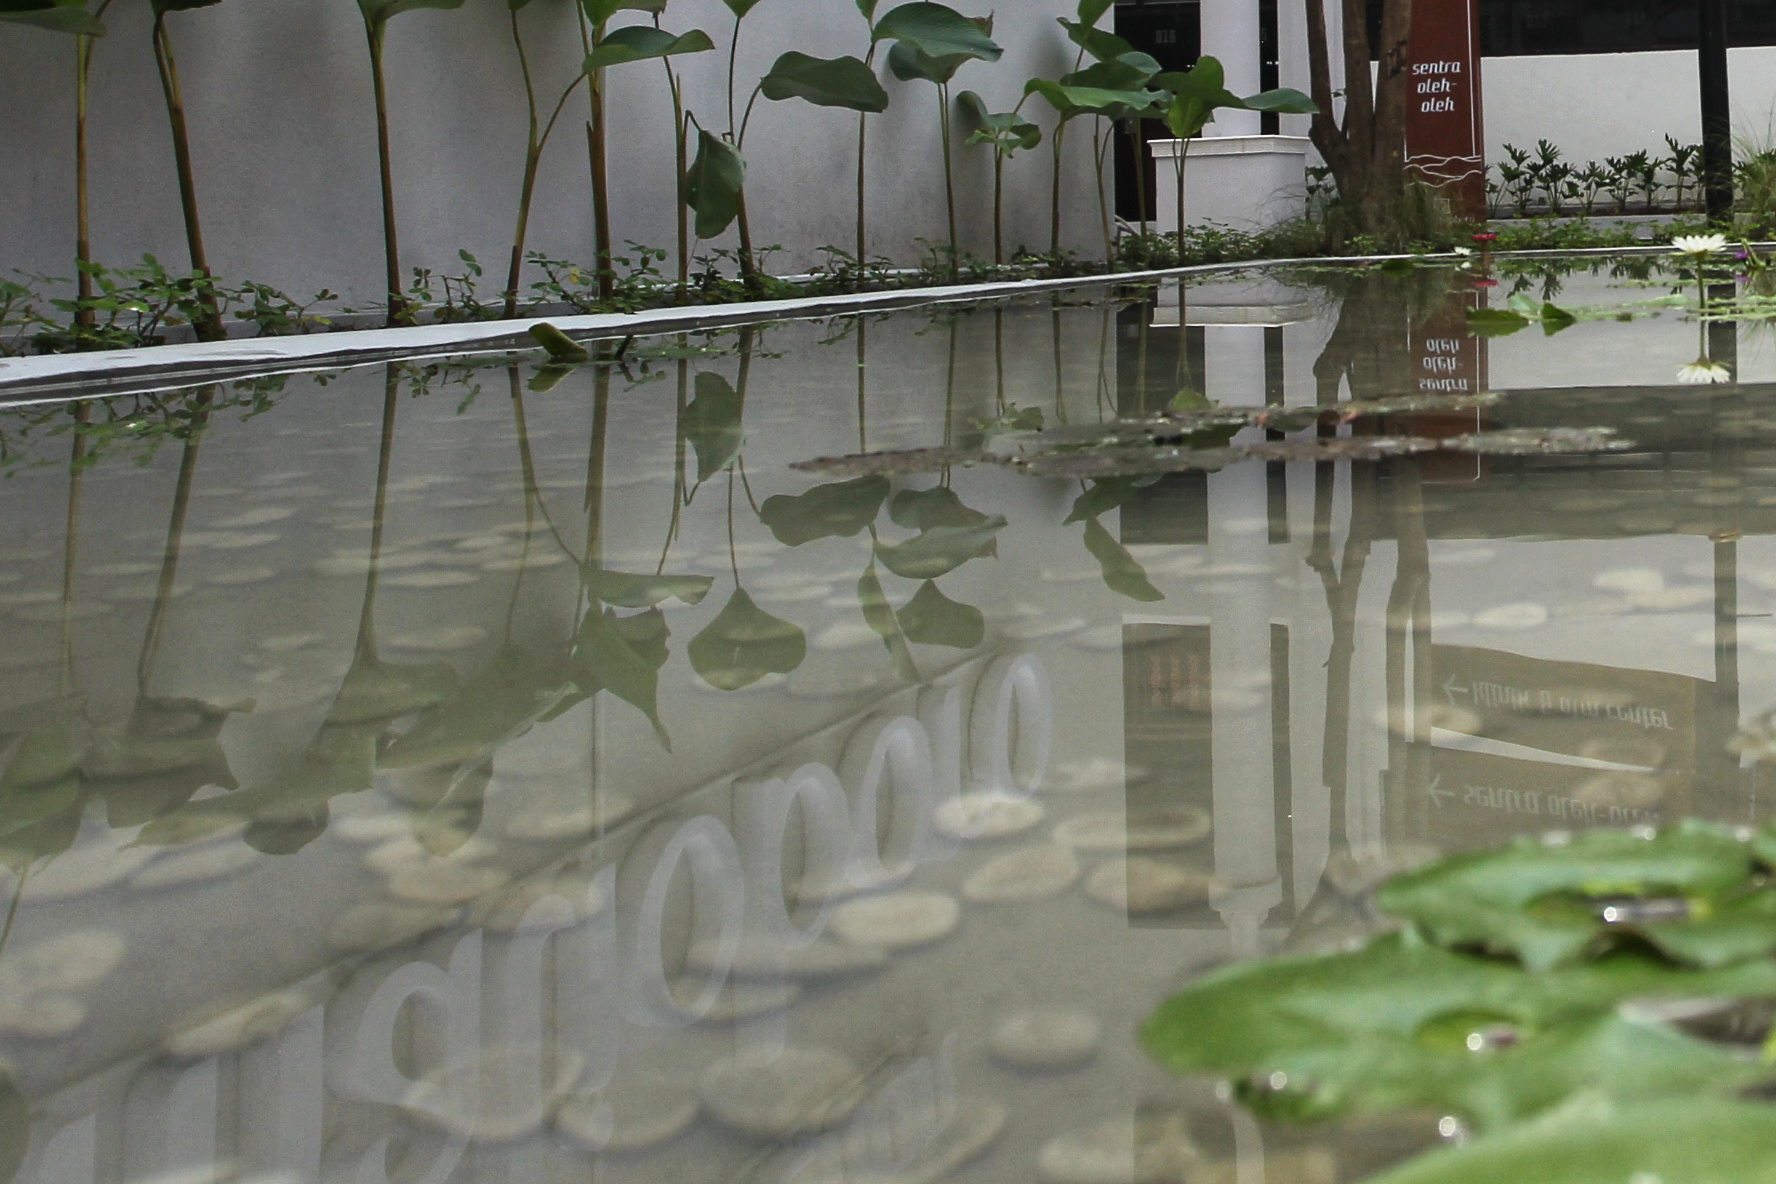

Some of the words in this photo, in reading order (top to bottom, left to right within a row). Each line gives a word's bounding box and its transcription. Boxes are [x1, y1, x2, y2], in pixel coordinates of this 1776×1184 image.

[1412, 60, 1462, 75] sentra
[1417, 78, 1457, 93] oleh-
[1421, 97, 1455, 112] oleh
